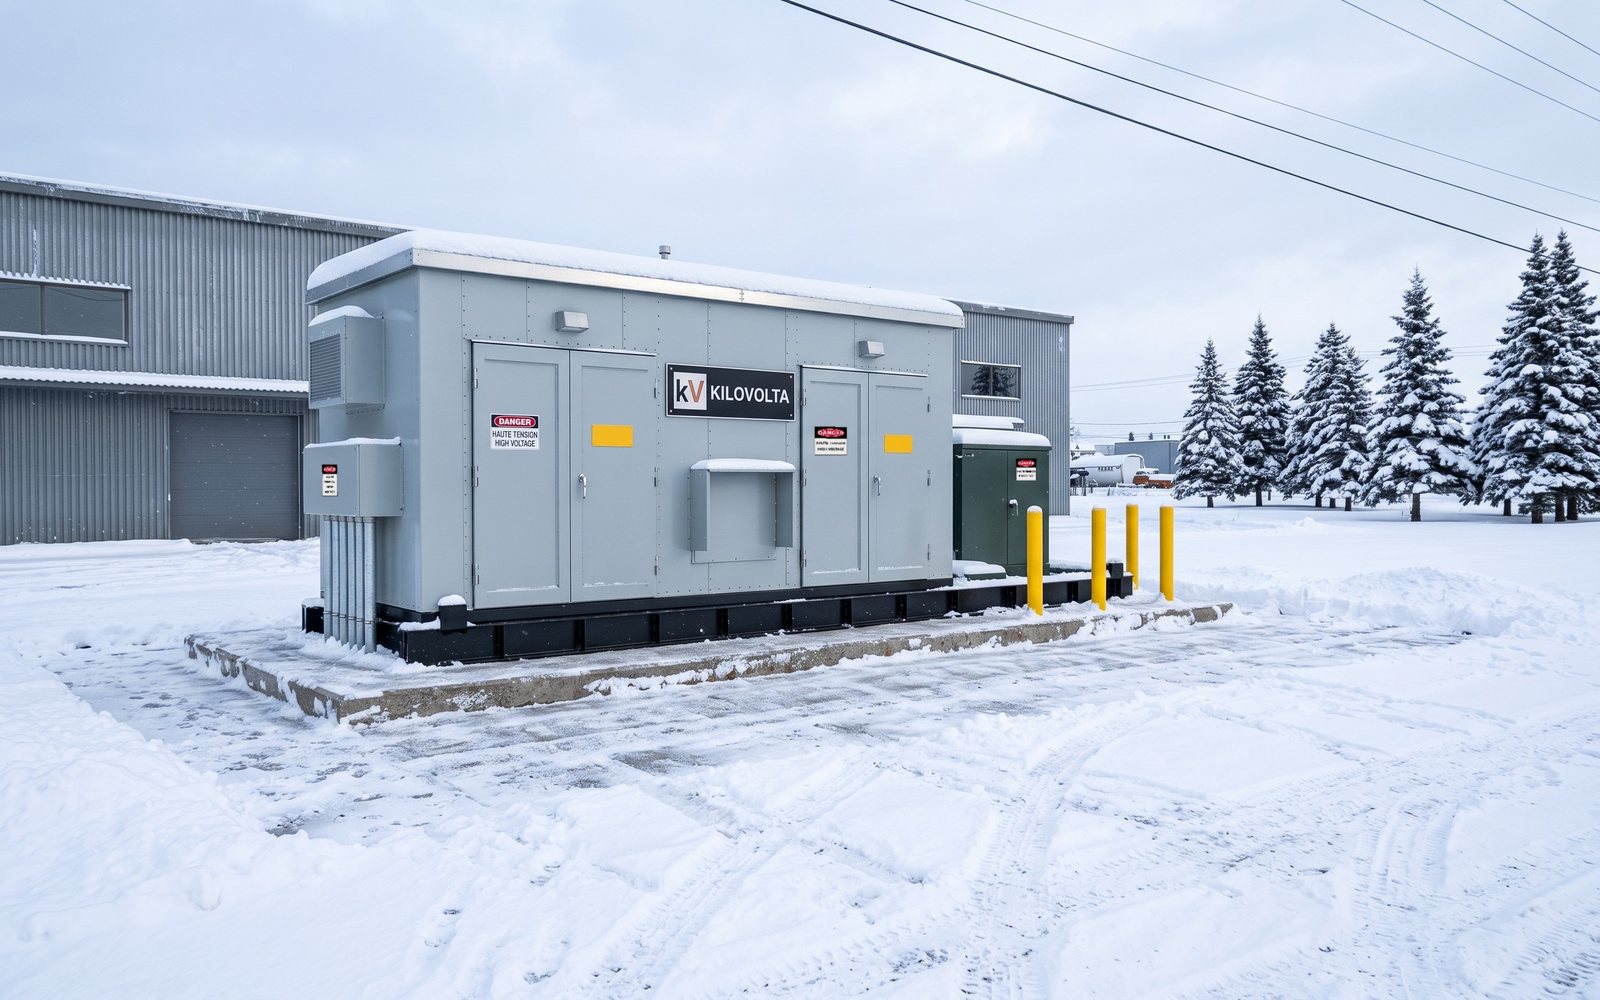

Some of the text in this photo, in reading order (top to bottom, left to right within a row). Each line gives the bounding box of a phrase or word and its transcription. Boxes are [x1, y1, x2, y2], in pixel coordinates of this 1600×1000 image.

[676, 379, 790, 404] kV KILOVOLTA
[498, 417, 531, 426] DANGER
[492, 430, 538, 439] HAUTE TENSION
[495, 439, 536, 448] HIGH VOLTAGE
